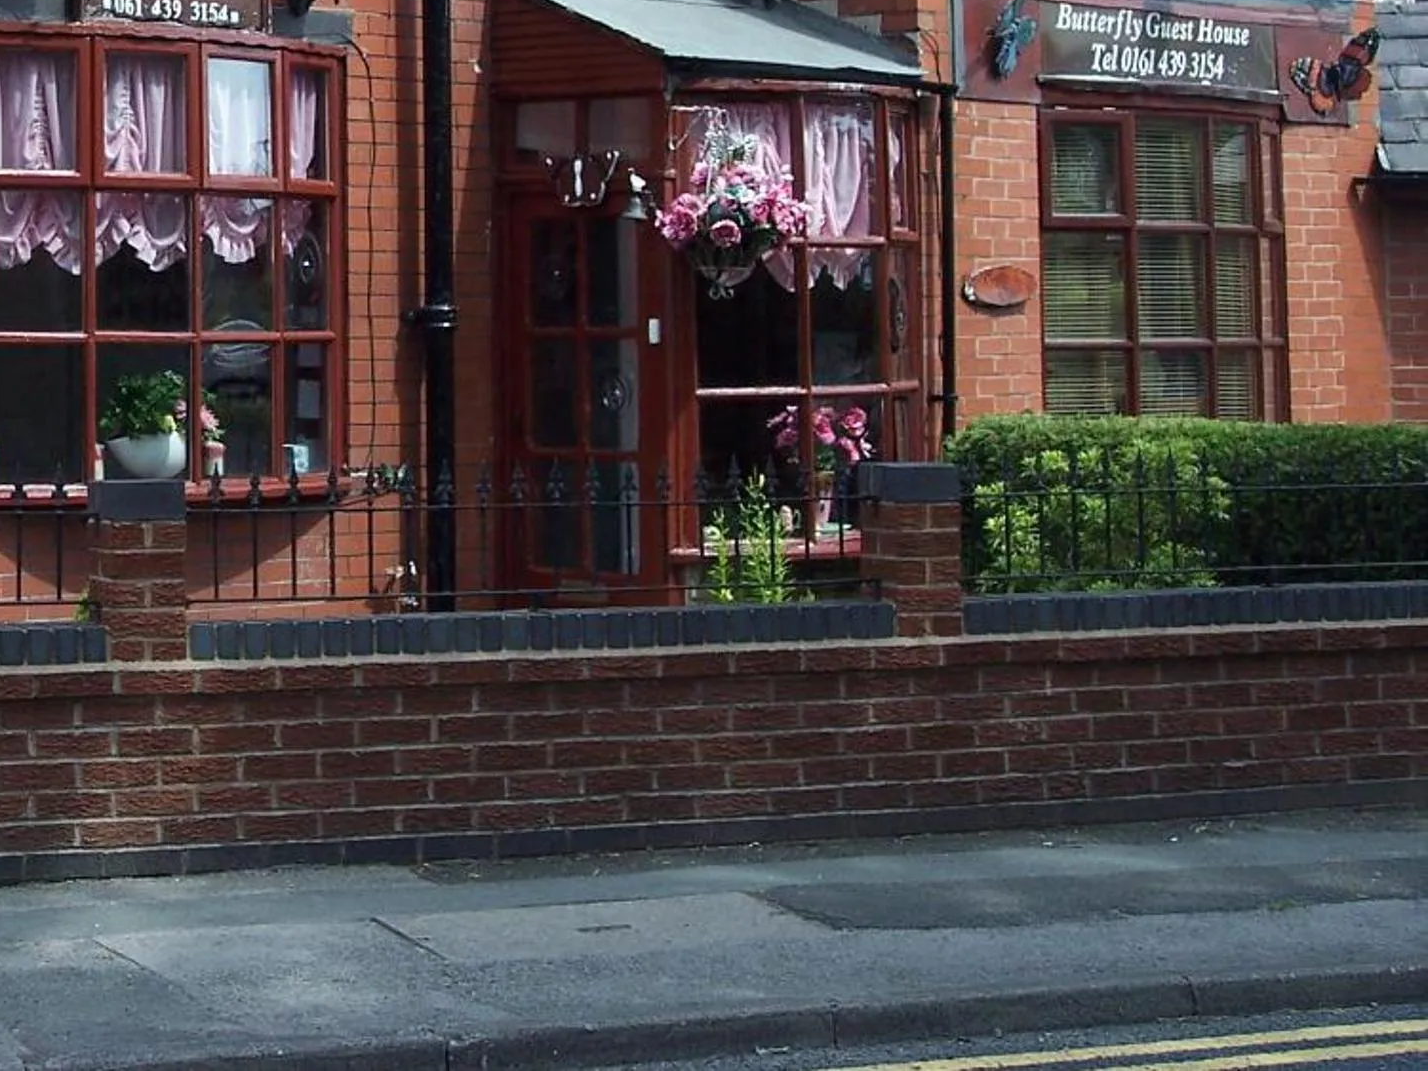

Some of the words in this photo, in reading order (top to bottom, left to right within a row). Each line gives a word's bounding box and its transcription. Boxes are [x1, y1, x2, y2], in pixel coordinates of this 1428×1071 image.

[190, 1, 229, 22] 3154
[1056, 3, 1143, 42] Butterfly
[1146, 12, 1194, 39] Guest
[1197, 19, 1250, 46] House
[1091, 43, 1117, 72] Tel
[1121, 46, 1155, 76] 0161
[1158, 50, 1186, 77] 439
[1189, 52, 1224, 79] 3154
